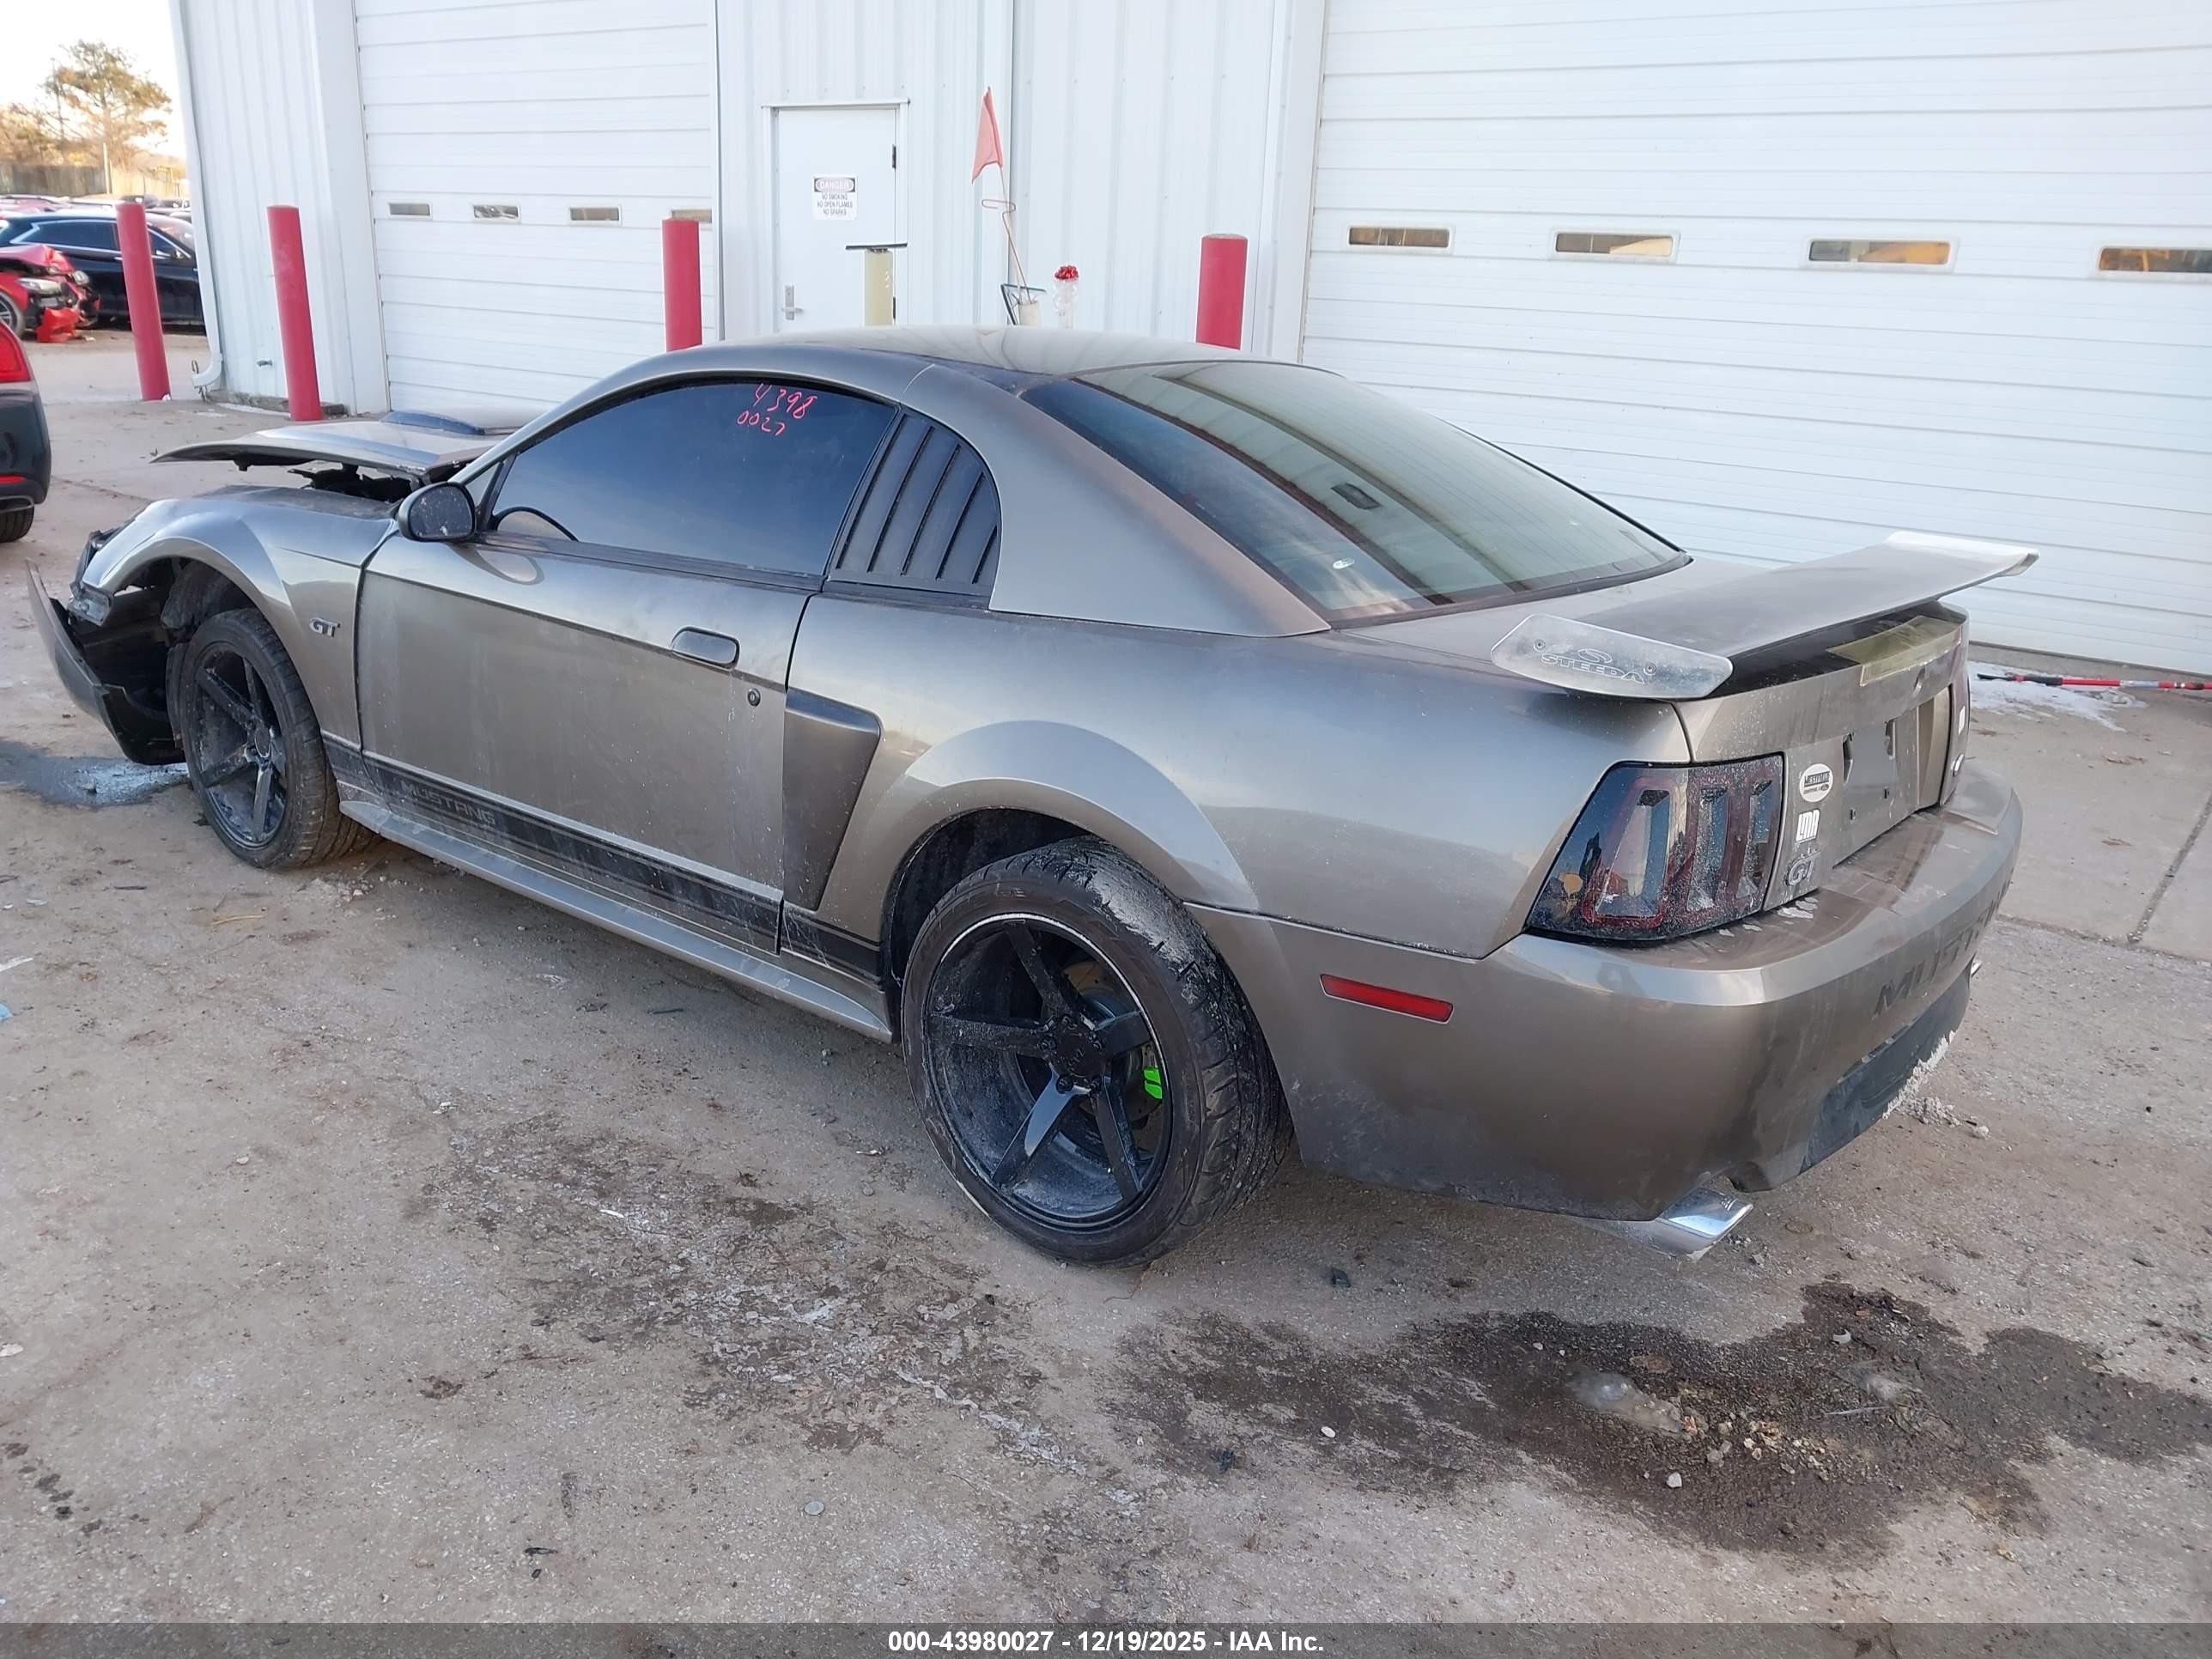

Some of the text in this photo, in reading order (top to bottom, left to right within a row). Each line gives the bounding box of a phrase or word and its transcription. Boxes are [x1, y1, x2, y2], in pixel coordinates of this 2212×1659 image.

[819, 180, 850, 190] DANGER
[753, 383, 817, 418] 4398
[737, 410, 786, 436] 0027
[309, 617, 340, 637] GT
[1541, 653, 1645, 684] STEEDA
[401, 781, 495, 825] MUSTANG
[1788, 852, 1820, 885] GT
